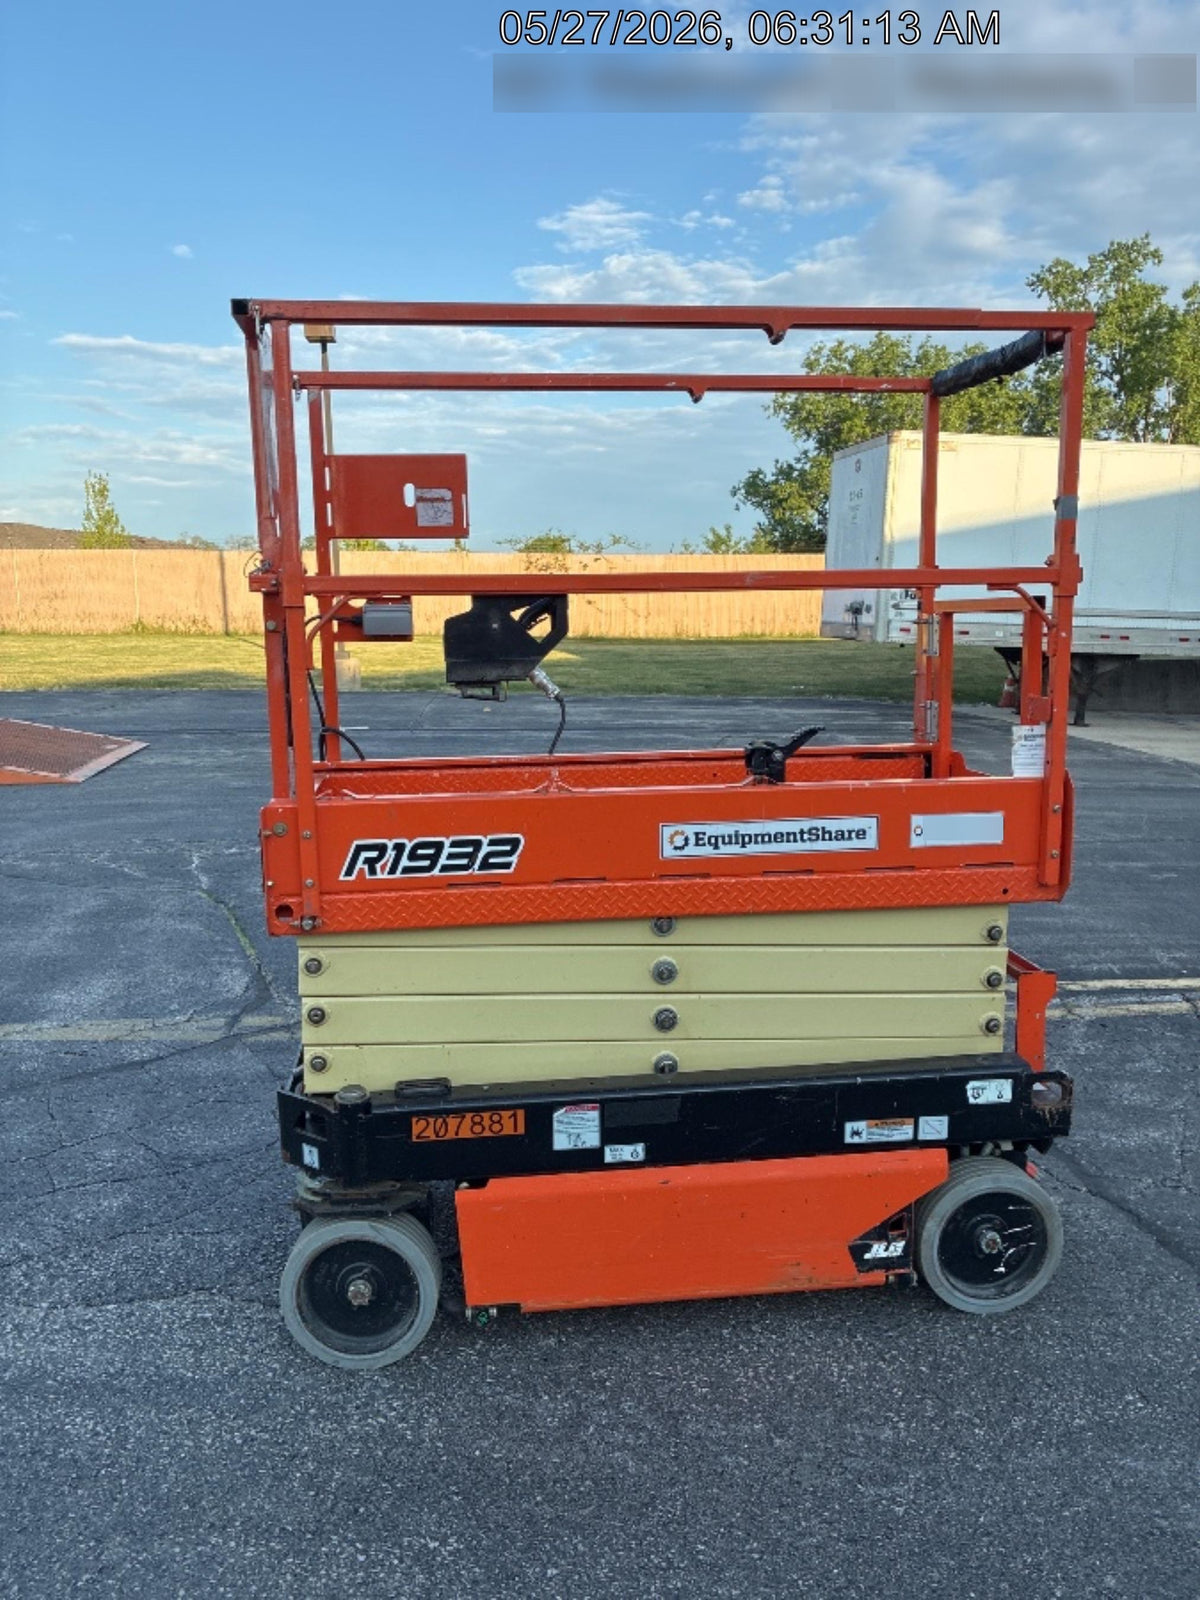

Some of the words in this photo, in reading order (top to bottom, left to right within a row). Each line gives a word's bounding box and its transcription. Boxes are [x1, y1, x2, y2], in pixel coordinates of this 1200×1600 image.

[692, 827, 867, 850] EquipmentShare
[339, 834, 524, 880] R1932
[415, 1110, 518, 1139] 207881
